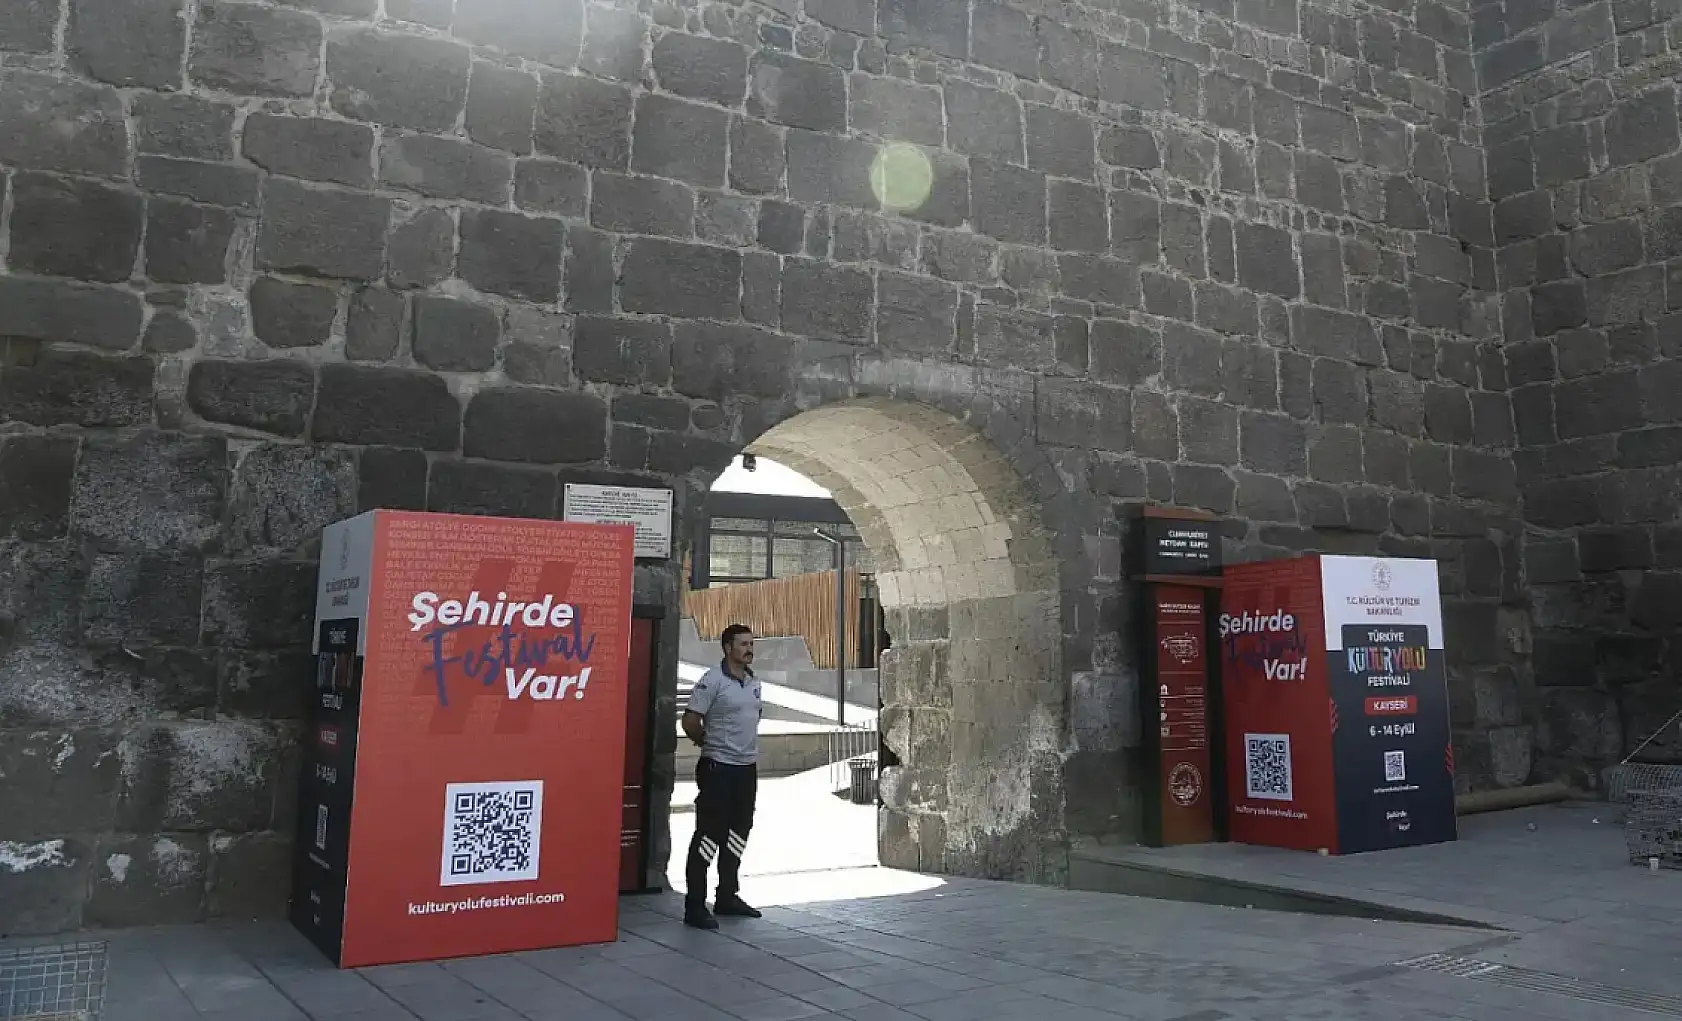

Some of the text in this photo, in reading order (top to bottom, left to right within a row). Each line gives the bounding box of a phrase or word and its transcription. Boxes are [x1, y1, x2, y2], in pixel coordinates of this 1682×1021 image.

[407, 591, 574, 632] Şehirde
[1218, 608, 1295, 639] Şehirde
[1368, 629, 1405, 643] TÜRKİYE
[422, 604, 597, 708] Festival
[1263, 657, 1308, 681] Var!
[1367, 673, 1410, 687] FESTİVALİ
[505, 667, 593, 701] Var!
[1370, 725, 1376, 736] 6
[1383, 725, 1393, 735] 14
[407, 892, 565, 916] kulturyolufestivali.com
